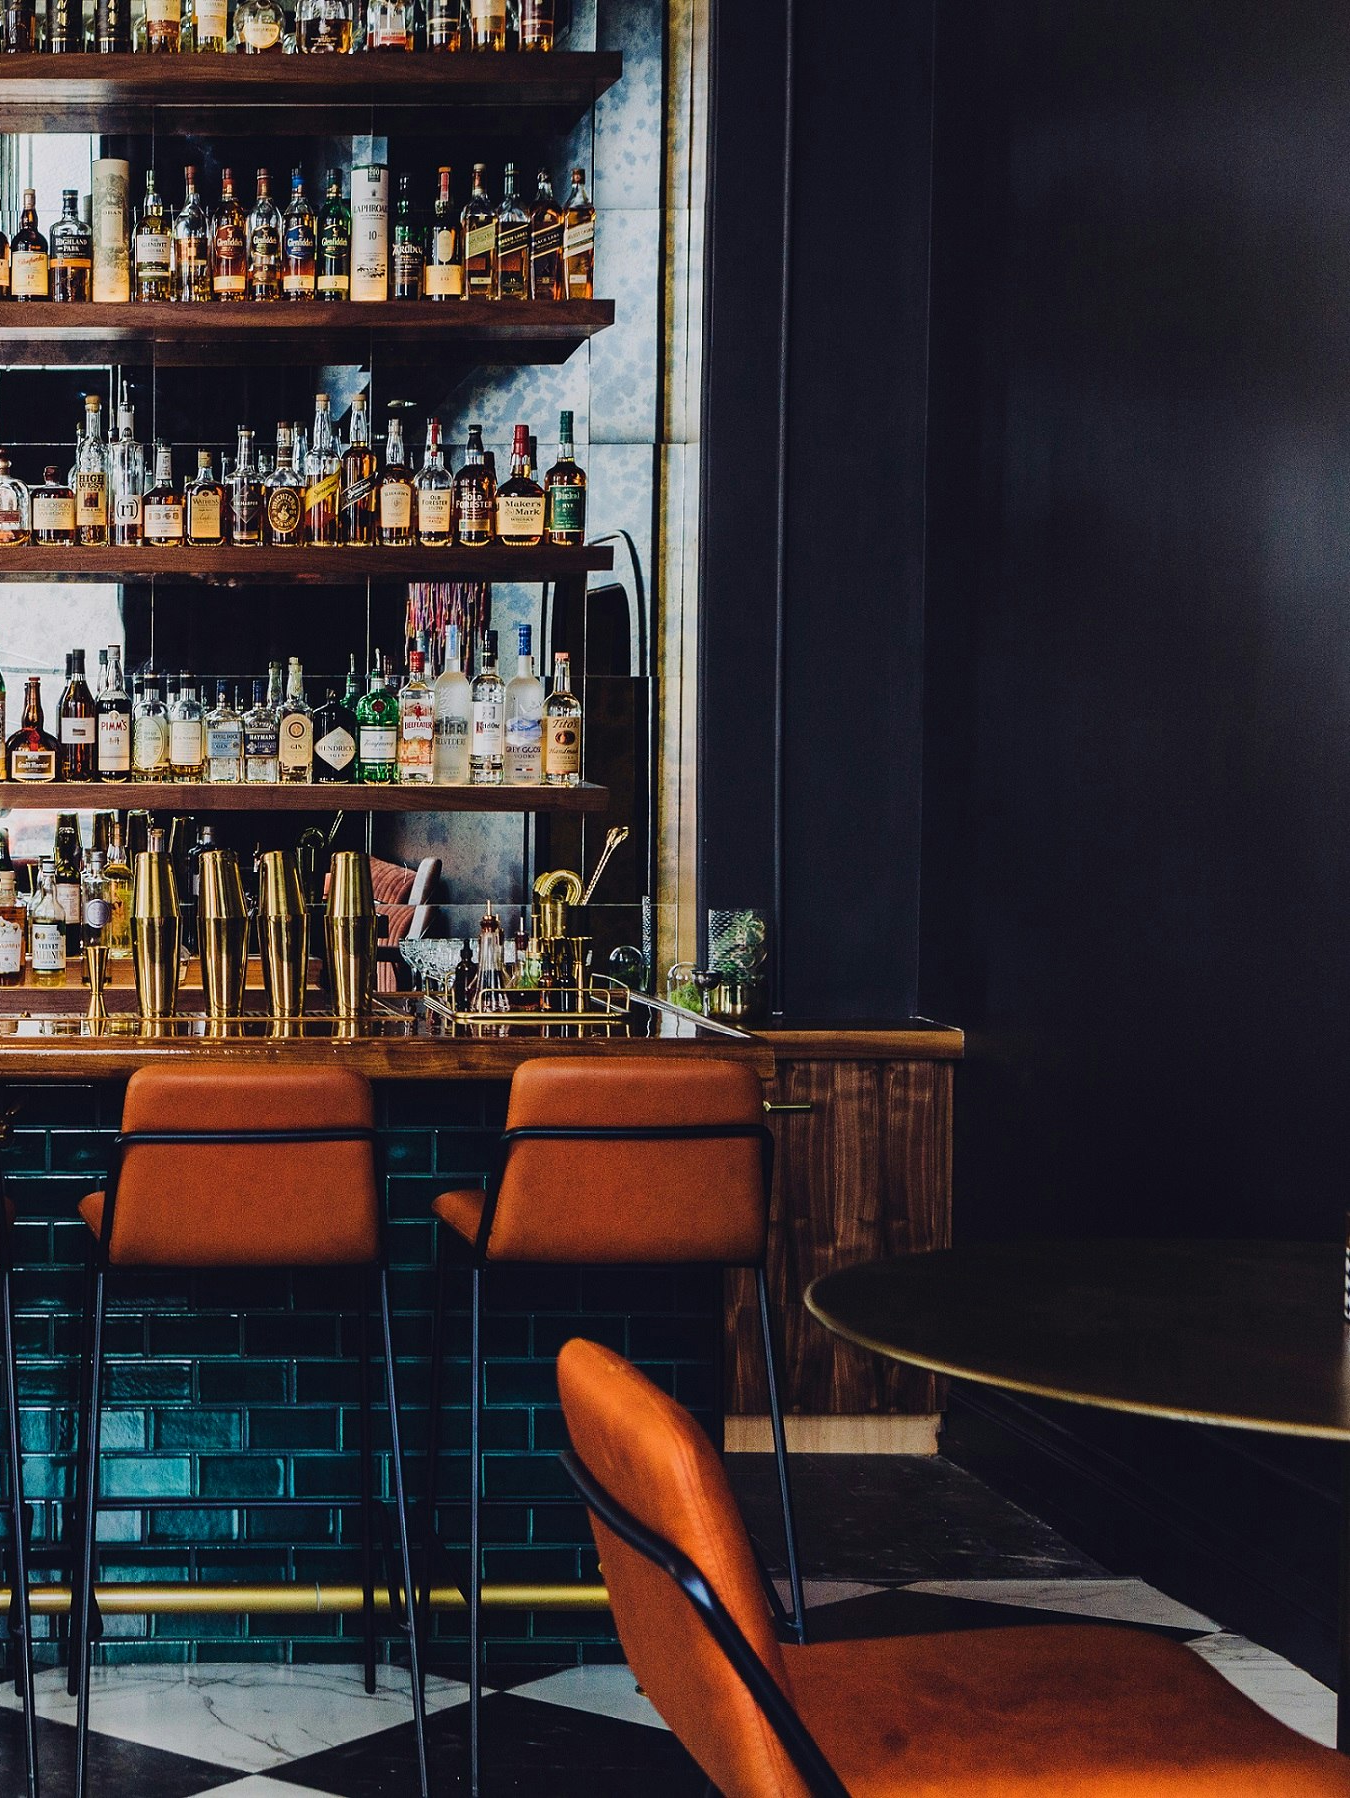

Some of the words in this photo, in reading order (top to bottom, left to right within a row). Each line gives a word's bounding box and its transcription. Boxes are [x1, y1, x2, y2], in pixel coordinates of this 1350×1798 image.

[367, 231, 378, 240] 10
[55, 238, 88, 246] HIGHLAND
[79, 474, 105, 482] HIGH
[456, 501, 492, 509] FORESTER
[504, 500, 542, 508] Maker's
[515, 507, 542, 516] Mark
[101, 720, 128, 731] PIMM'S
[404, 721, 433, 730] BEEFEATER
[553, 719, 578, 729] Tito's
